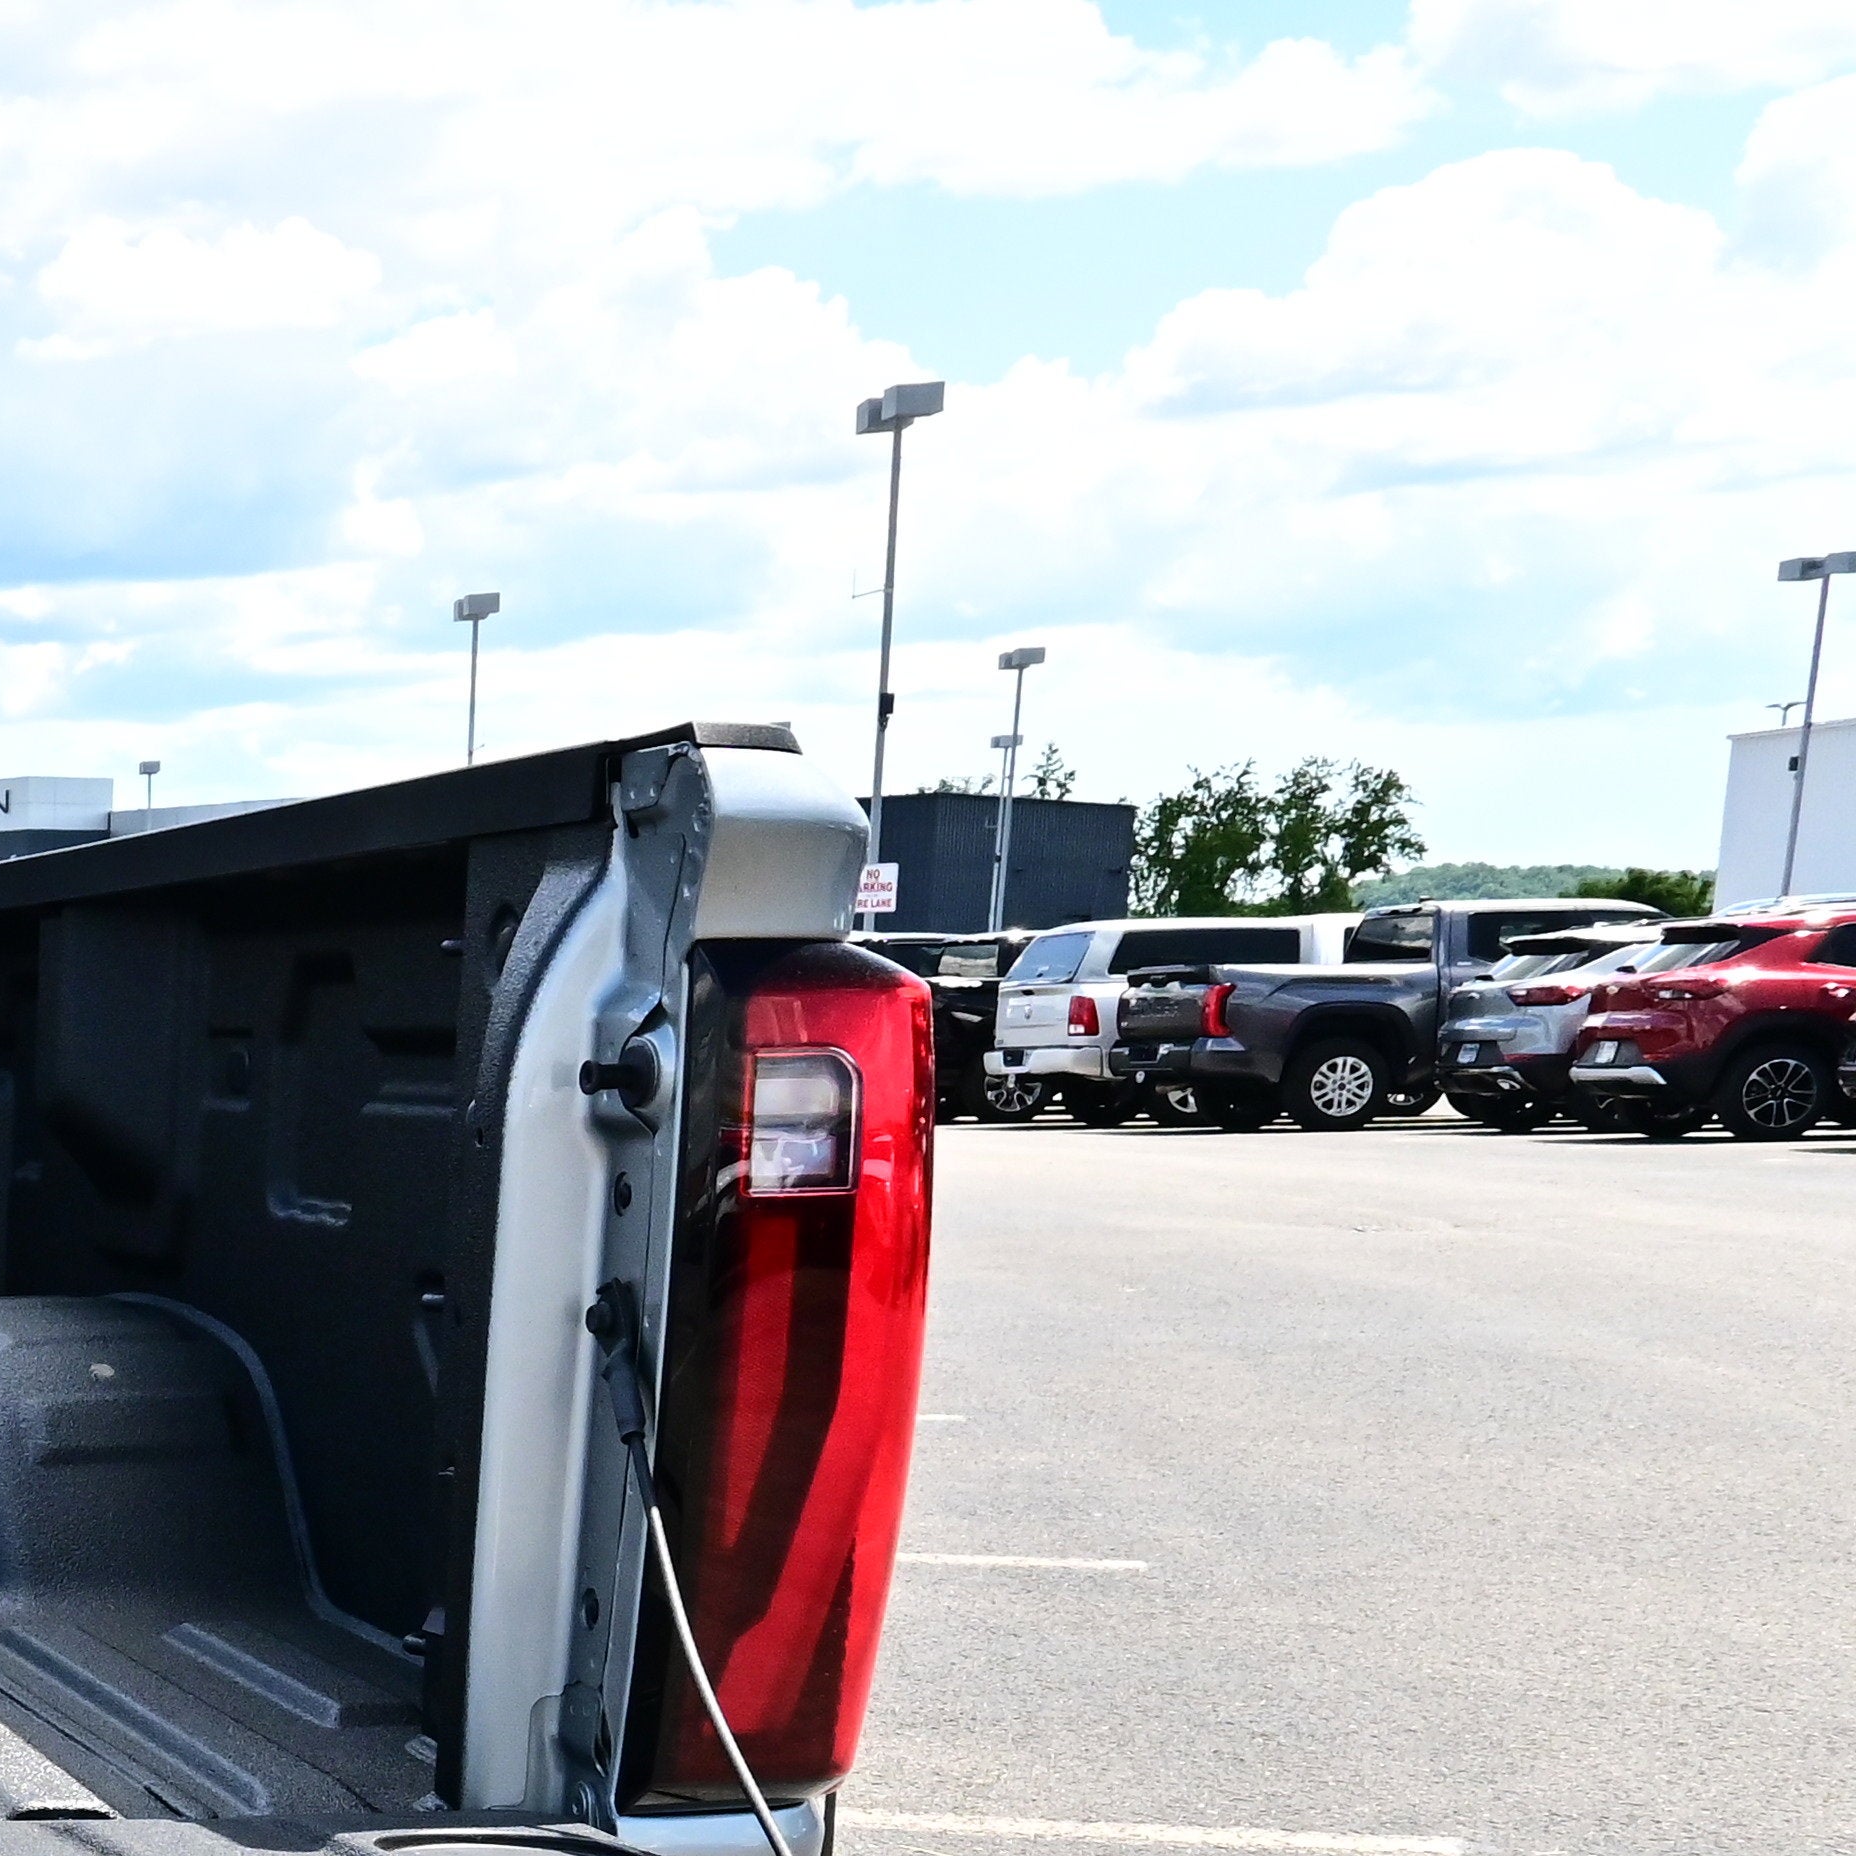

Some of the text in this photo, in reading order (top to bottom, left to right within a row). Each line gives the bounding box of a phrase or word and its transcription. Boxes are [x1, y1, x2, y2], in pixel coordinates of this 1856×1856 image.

[866, 869, 880, 879] NO
[860, 882, 893, 892] RKING
[858, 899, 869, 908] RE
